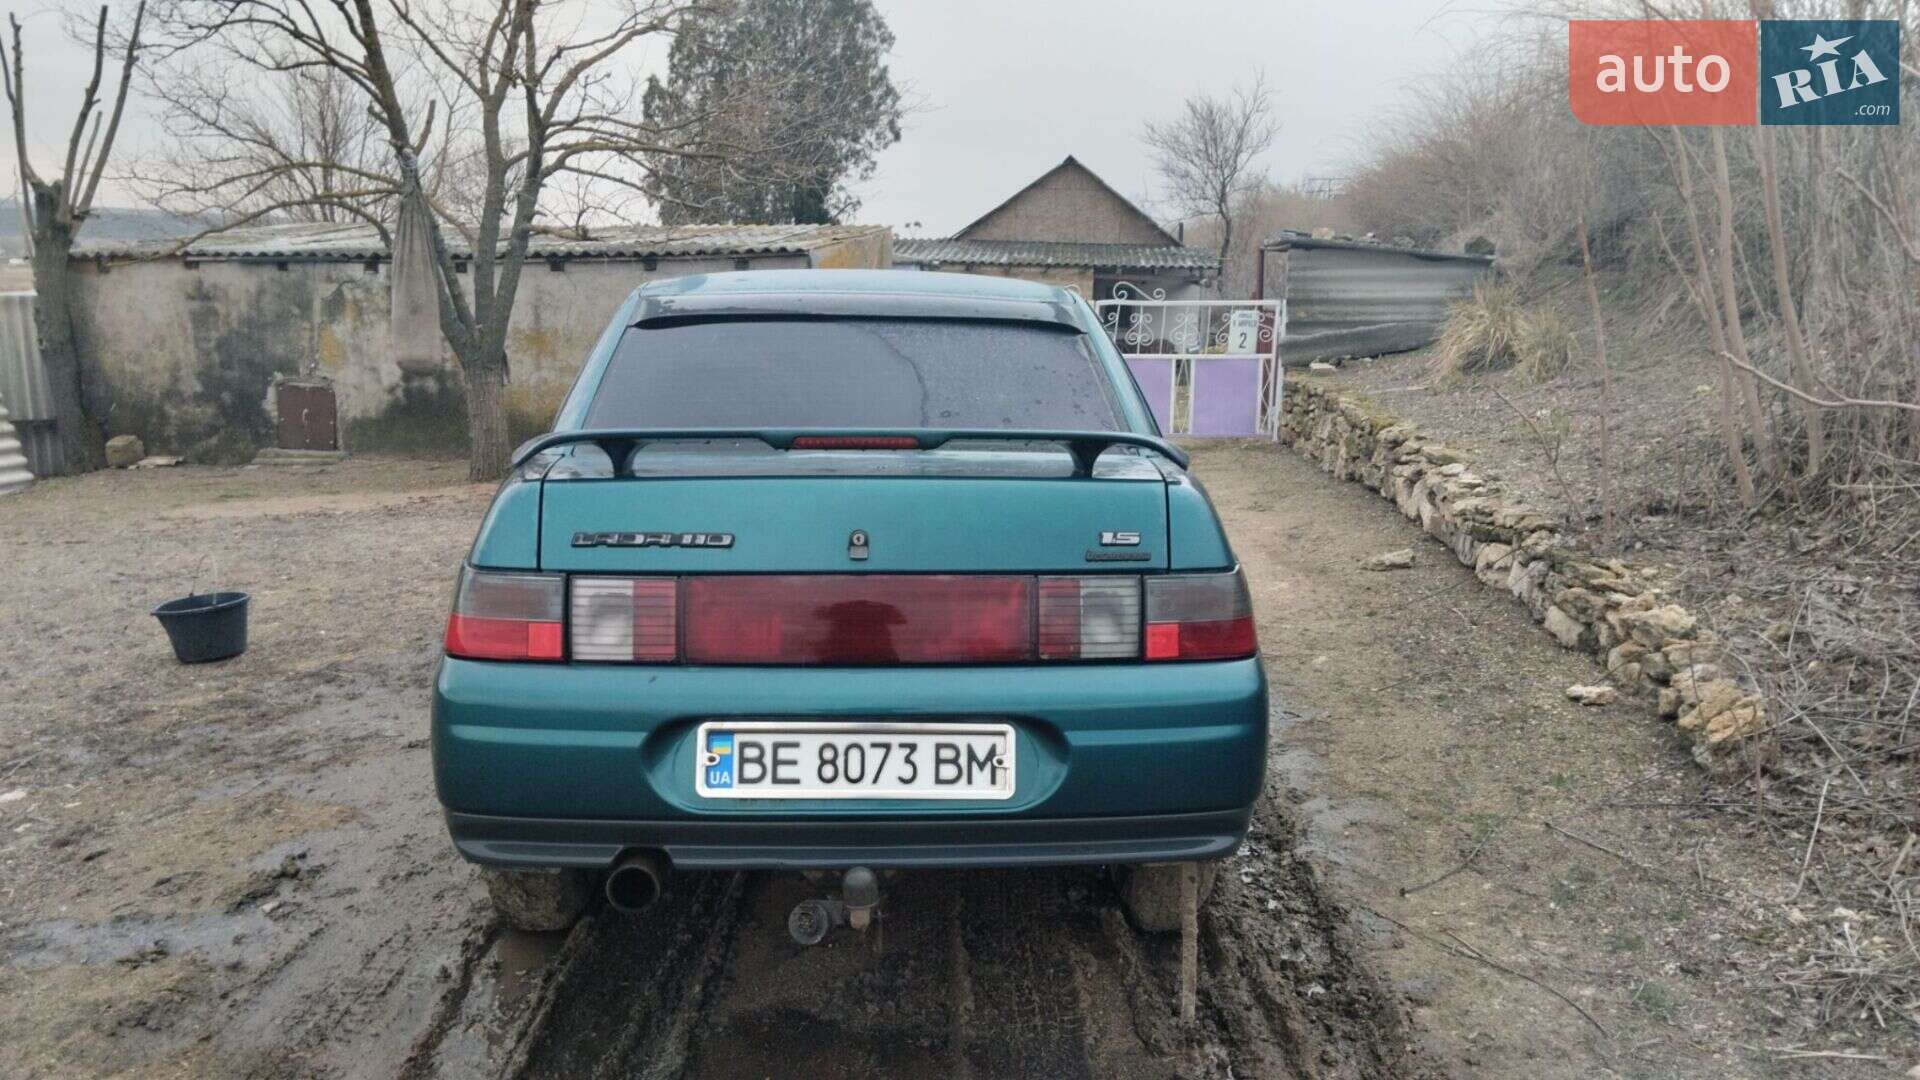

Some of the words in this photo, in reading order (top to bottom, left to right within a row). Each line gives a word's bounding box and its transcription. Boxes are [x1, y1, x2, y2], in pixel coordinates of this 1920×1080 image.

[1238, 332, 1247, 349] 2
[738, 741, 801, 785] BE
[817, 742, 917, 785] 8073
[934, 742, 997, 786] BM
[710, 771, 730, 785] UA
